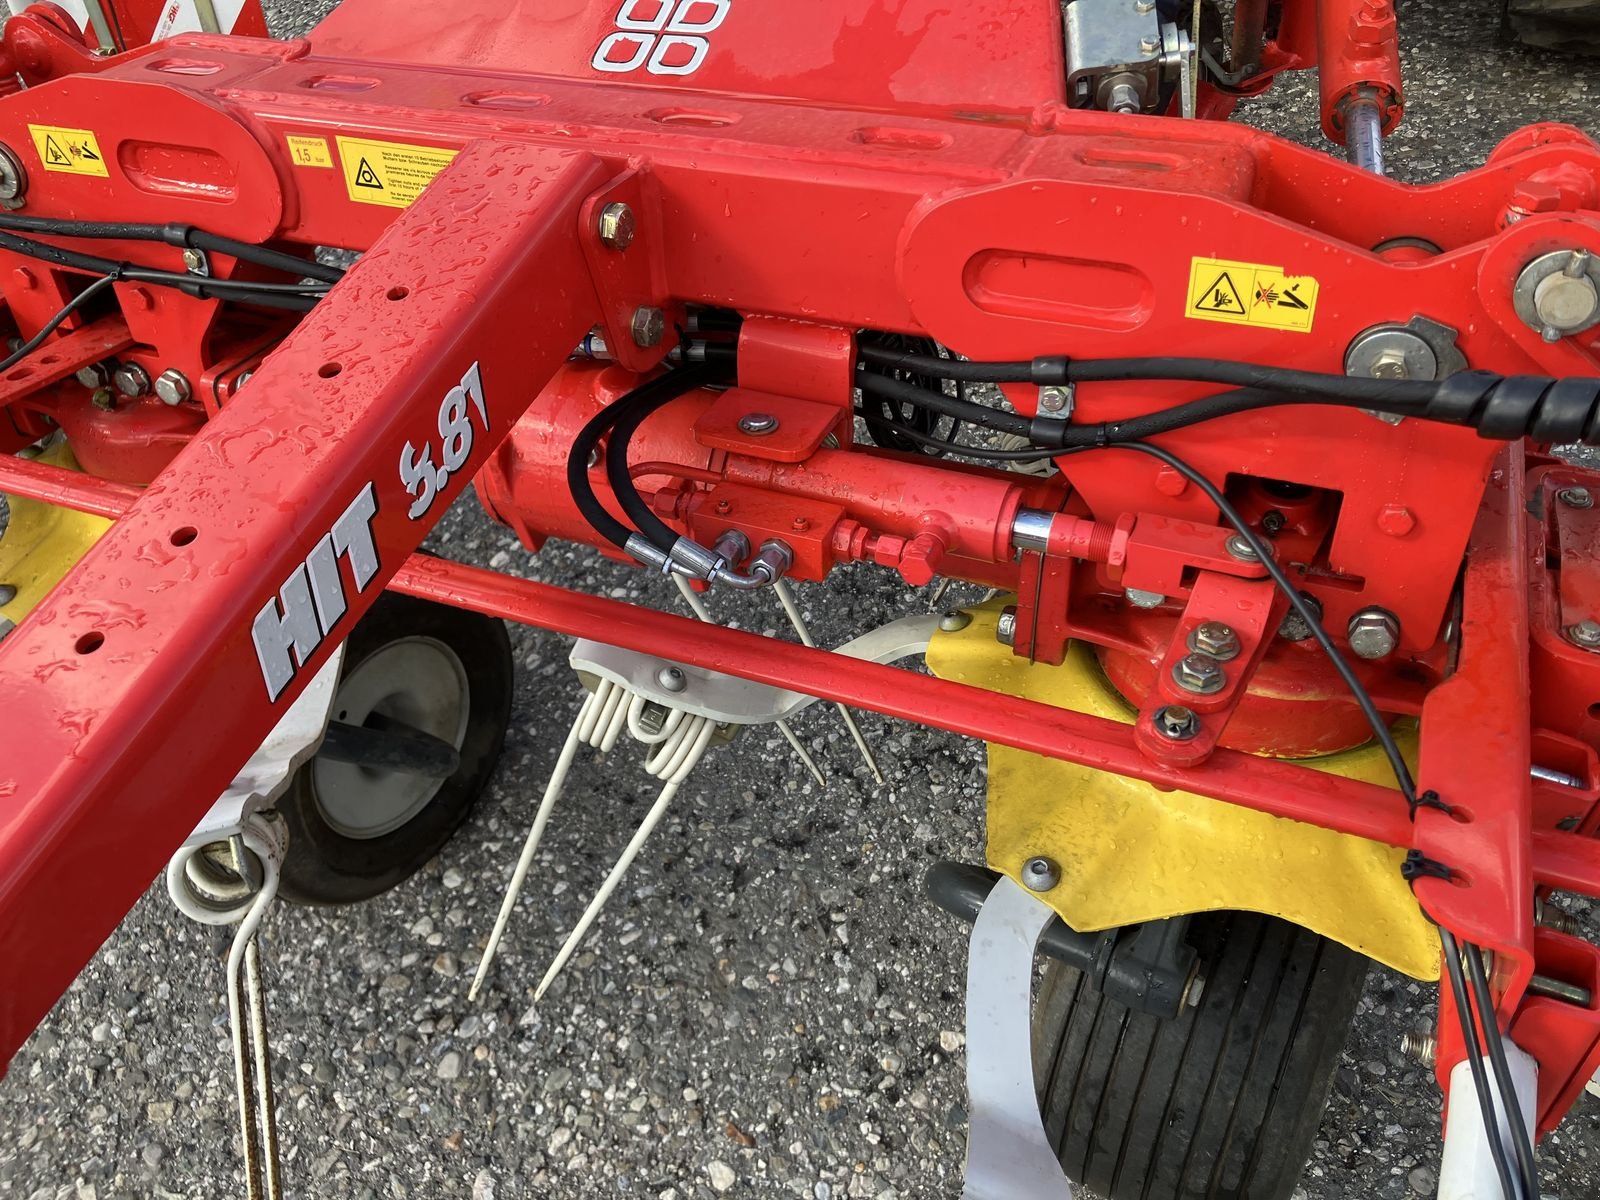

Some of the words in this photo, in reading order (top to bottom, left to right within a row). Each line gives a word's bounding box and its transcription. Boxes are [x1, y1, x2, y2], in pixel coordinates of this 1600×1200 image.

[296, 147, 311, 164] 1,5
[251, 481, 379, 704] HIT
[400, 360, 490, 520] 5.81
